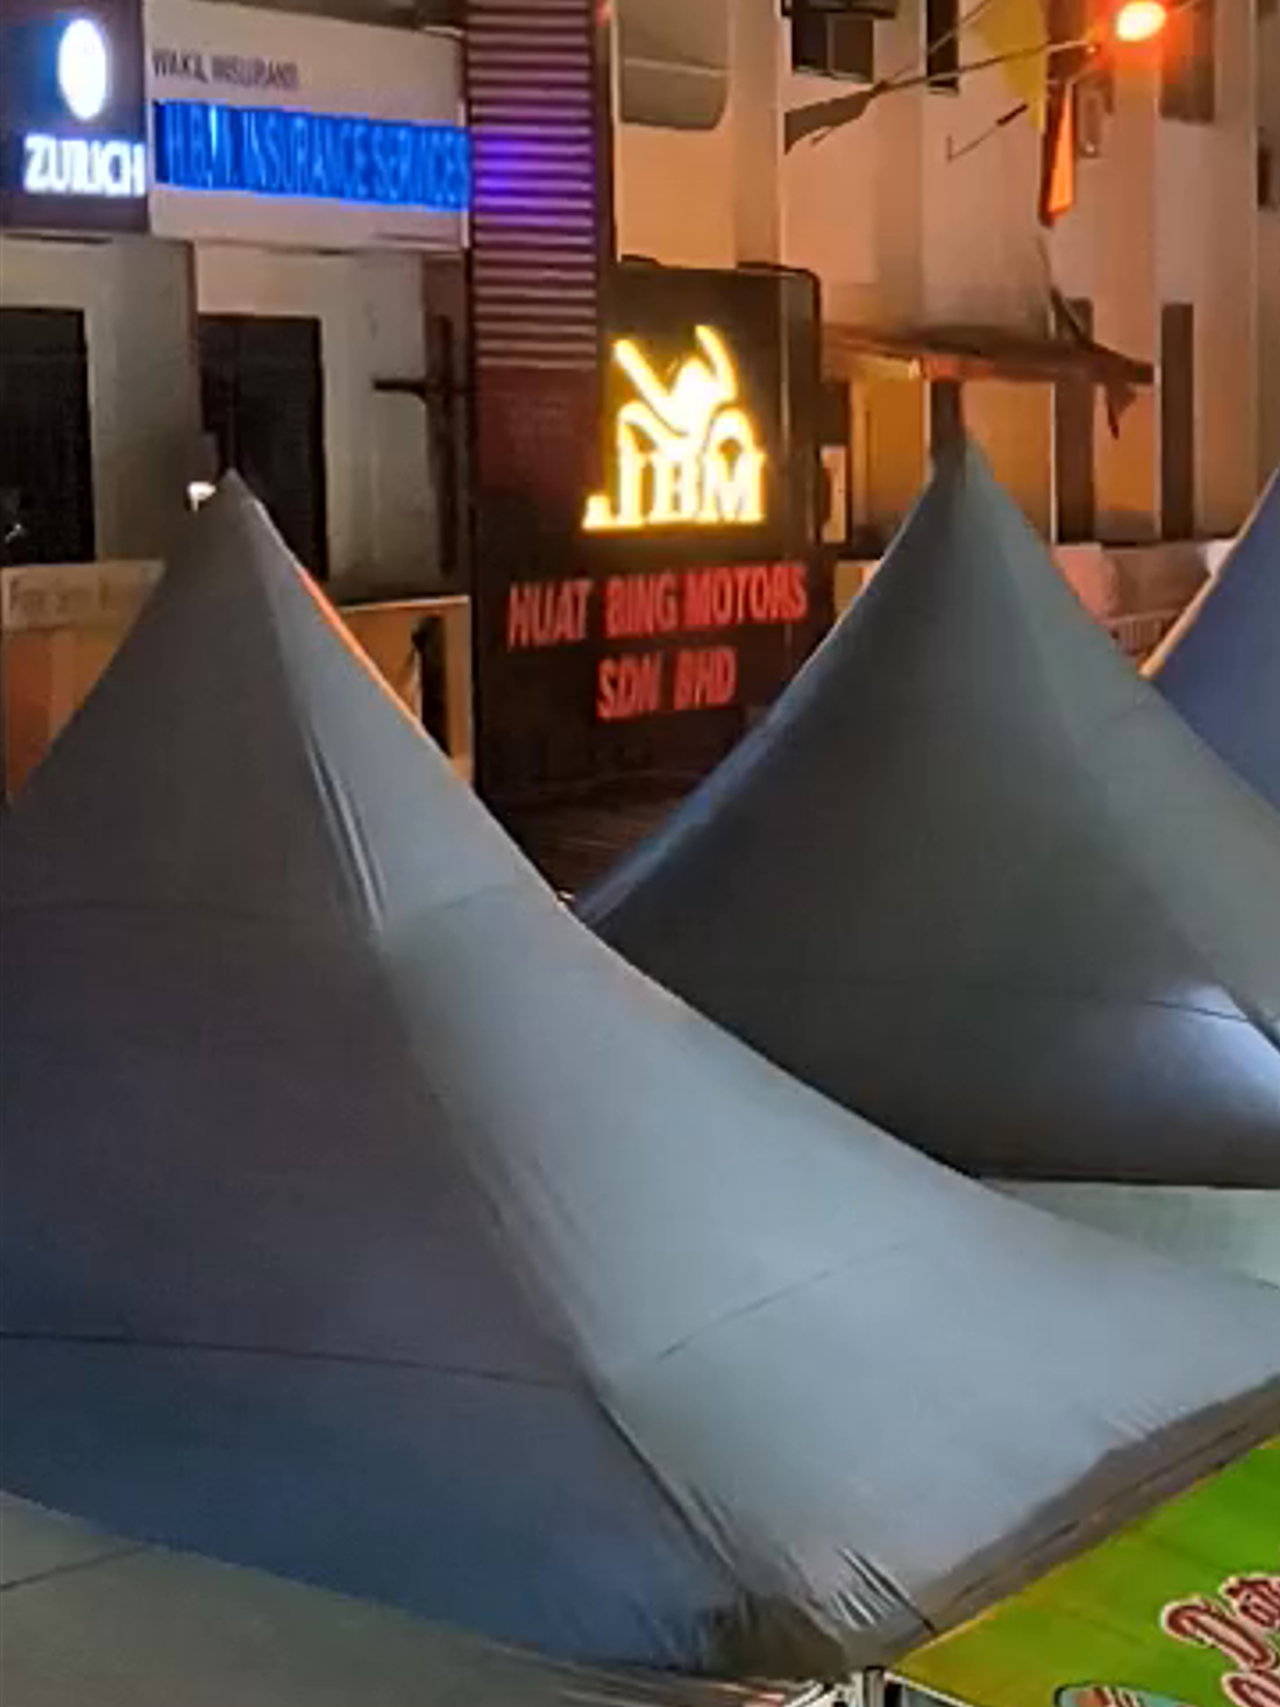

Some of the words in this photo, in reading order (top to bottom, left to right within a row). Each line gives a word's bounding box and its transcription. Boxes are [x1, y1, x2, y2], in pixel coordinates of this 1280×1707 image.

[23, 133, 146, 197] ZURICH
[243, 108, 370, 198] INSURANCE
[372, 122, 470, 209] SERVICES
[507, 579, 594, 652] HUAT
[604, 572, 680, 639] BING
[682, 563, 808, 627] MOTORS
[597, 650, 663, 722] SDN
[673, 646, 738, 711] BHD
